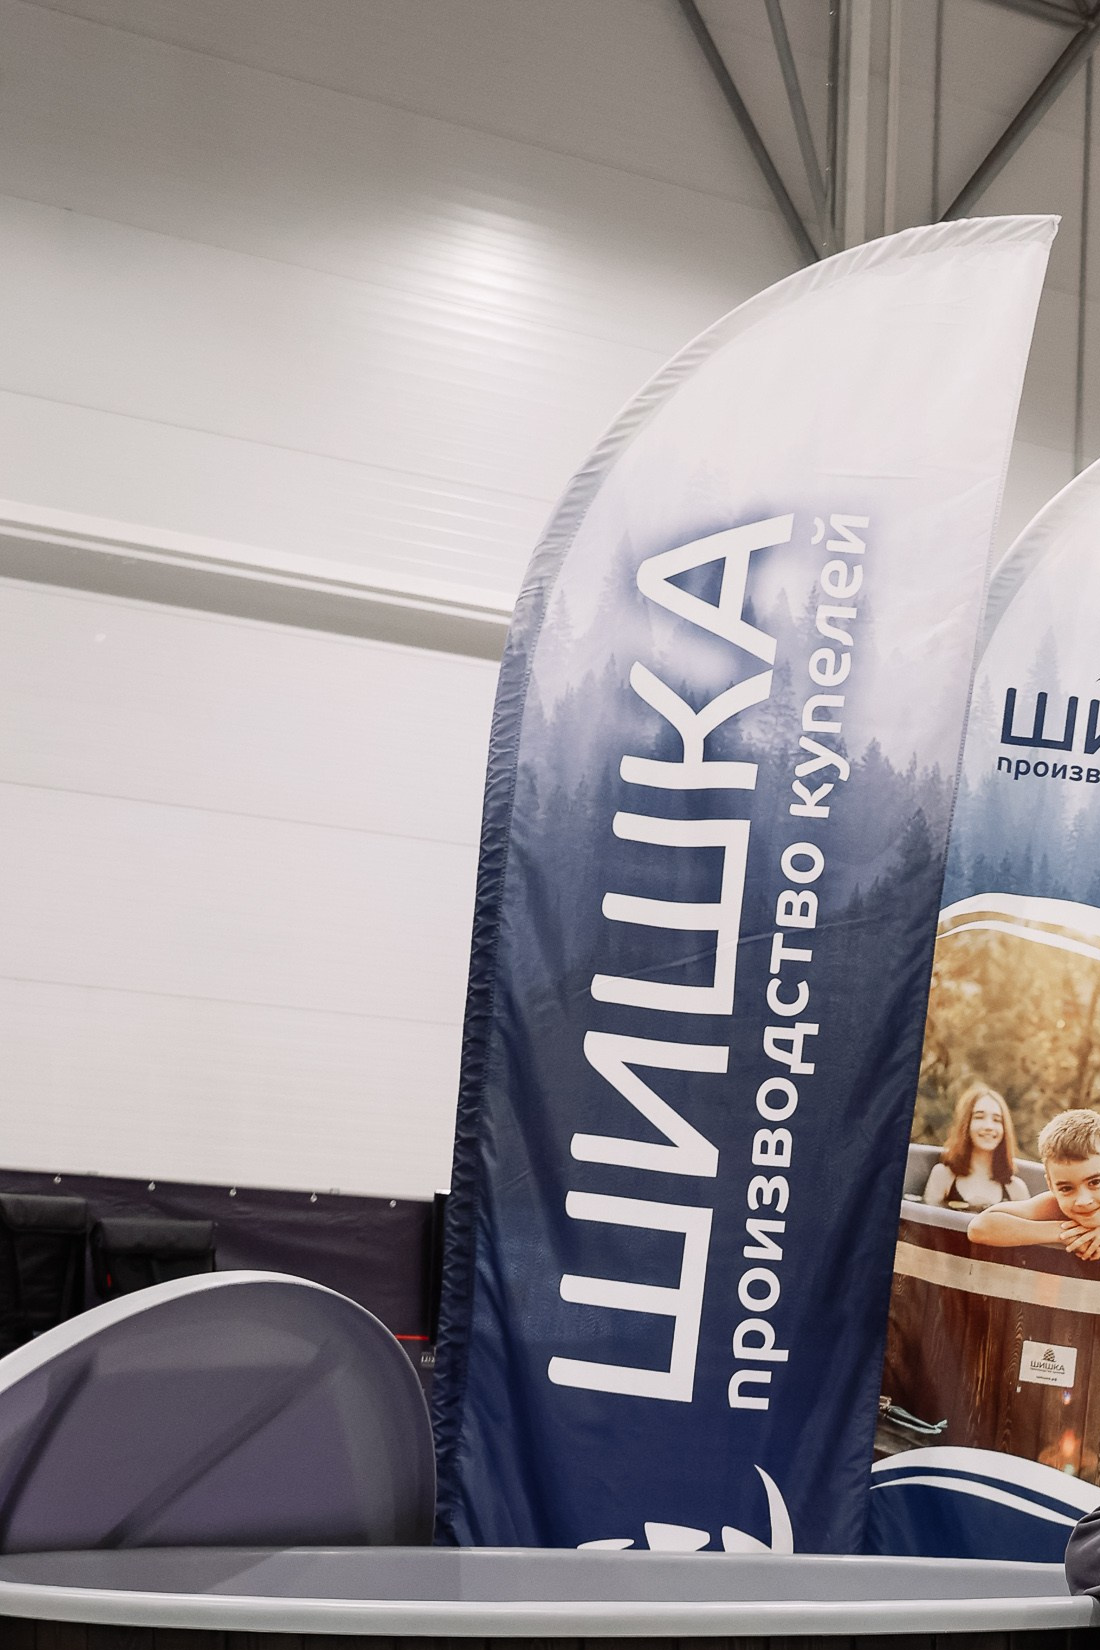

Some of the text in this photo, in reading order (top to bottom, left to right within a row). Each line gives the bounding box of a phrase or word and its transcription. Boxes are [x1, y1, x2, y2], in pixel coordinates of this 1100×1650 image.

[547, 513, 794, 1403] ШИШКА
[728, 513, 870, 1410] производство купелей
